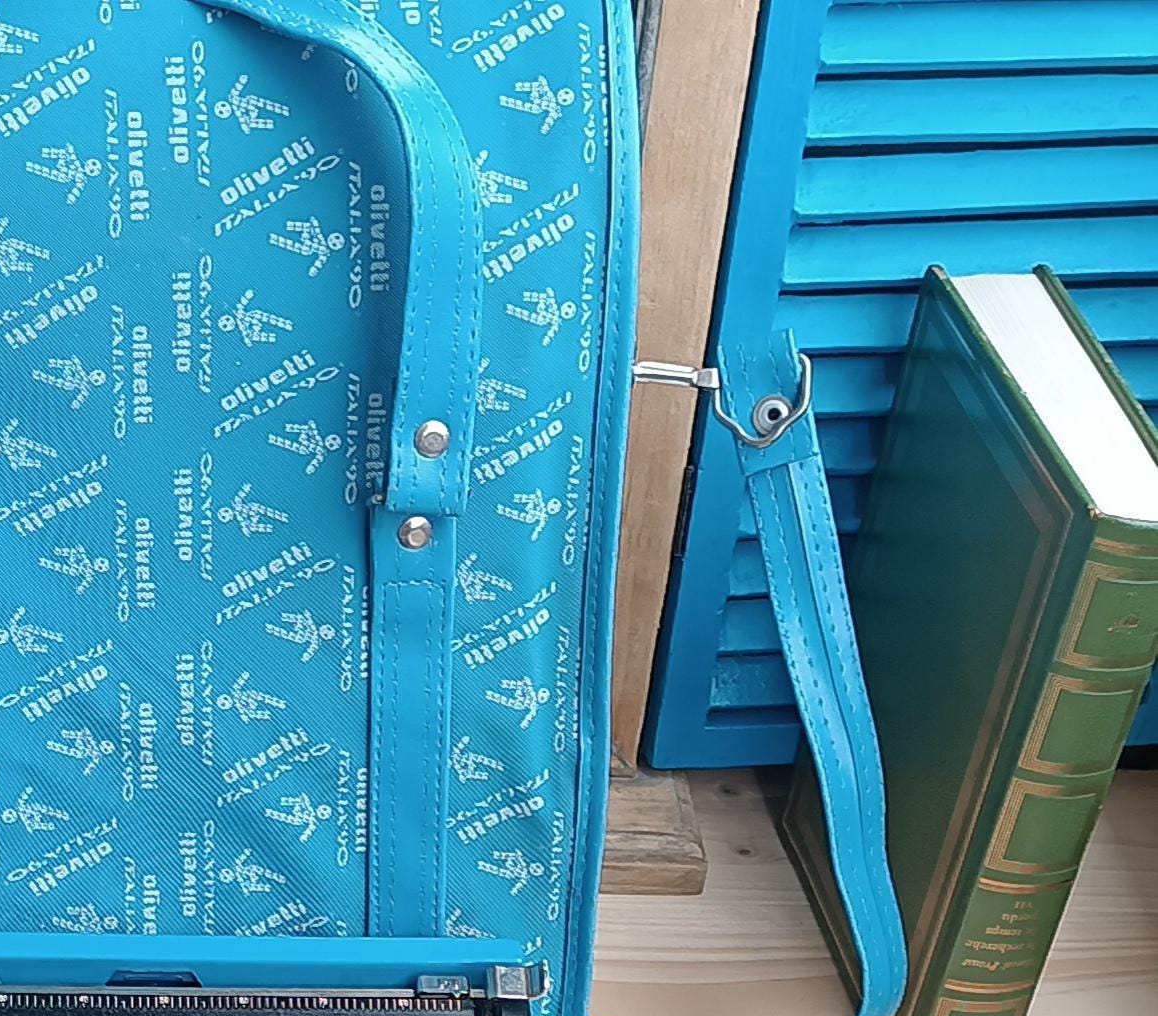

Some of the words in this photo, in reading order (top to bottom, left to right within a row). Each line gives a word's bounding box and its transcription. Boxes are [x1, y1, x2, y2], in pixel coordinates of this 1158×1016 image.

[473, 3, 565, 72] olivetti
[165, 56, 190, 164] olivetti
[126, 111, 150, 221] olivetti
[220, 136, 316, 205] olivetti
[370, 184, 390, 292] olivetti
[483, 213, 574, 283] olivetti
[5, 285, 98, 348] olivetti
[172, 271, 191, 373] olivetti
